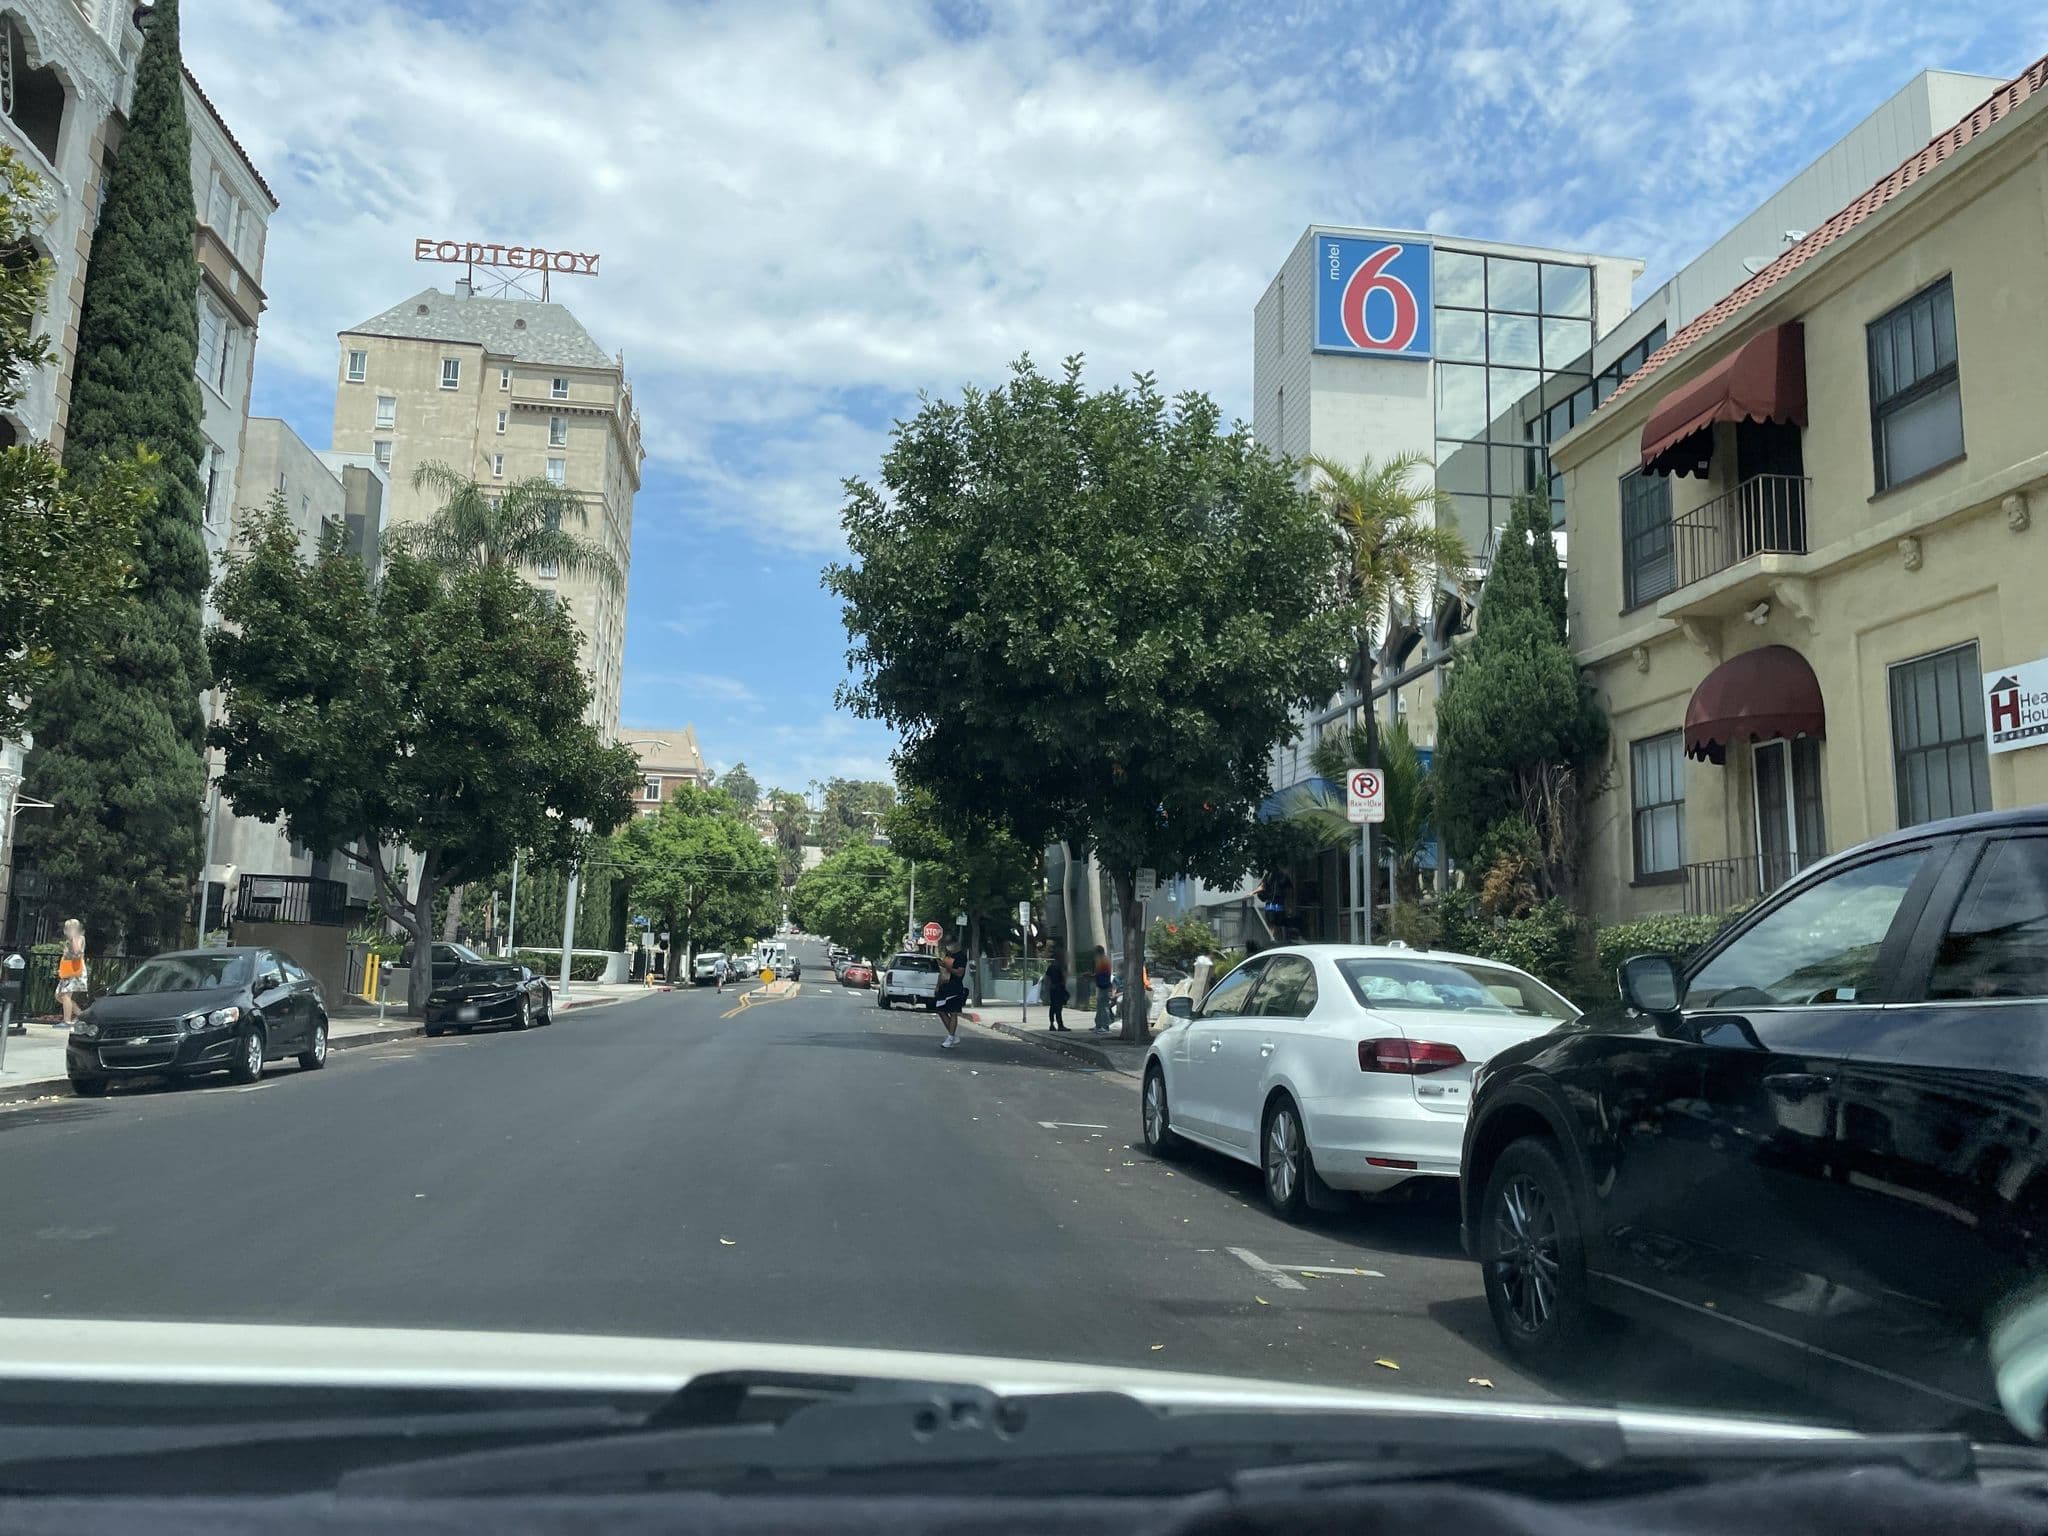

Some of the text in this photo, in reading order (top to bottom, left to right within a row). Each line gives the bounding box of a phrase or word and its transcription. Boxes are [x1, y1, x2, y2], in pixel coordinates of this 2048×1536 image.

[1328, 244, 1340, 280] motel
[1340, 244, 1419, 351] 6
[925, 928, 941, 936] STOP
